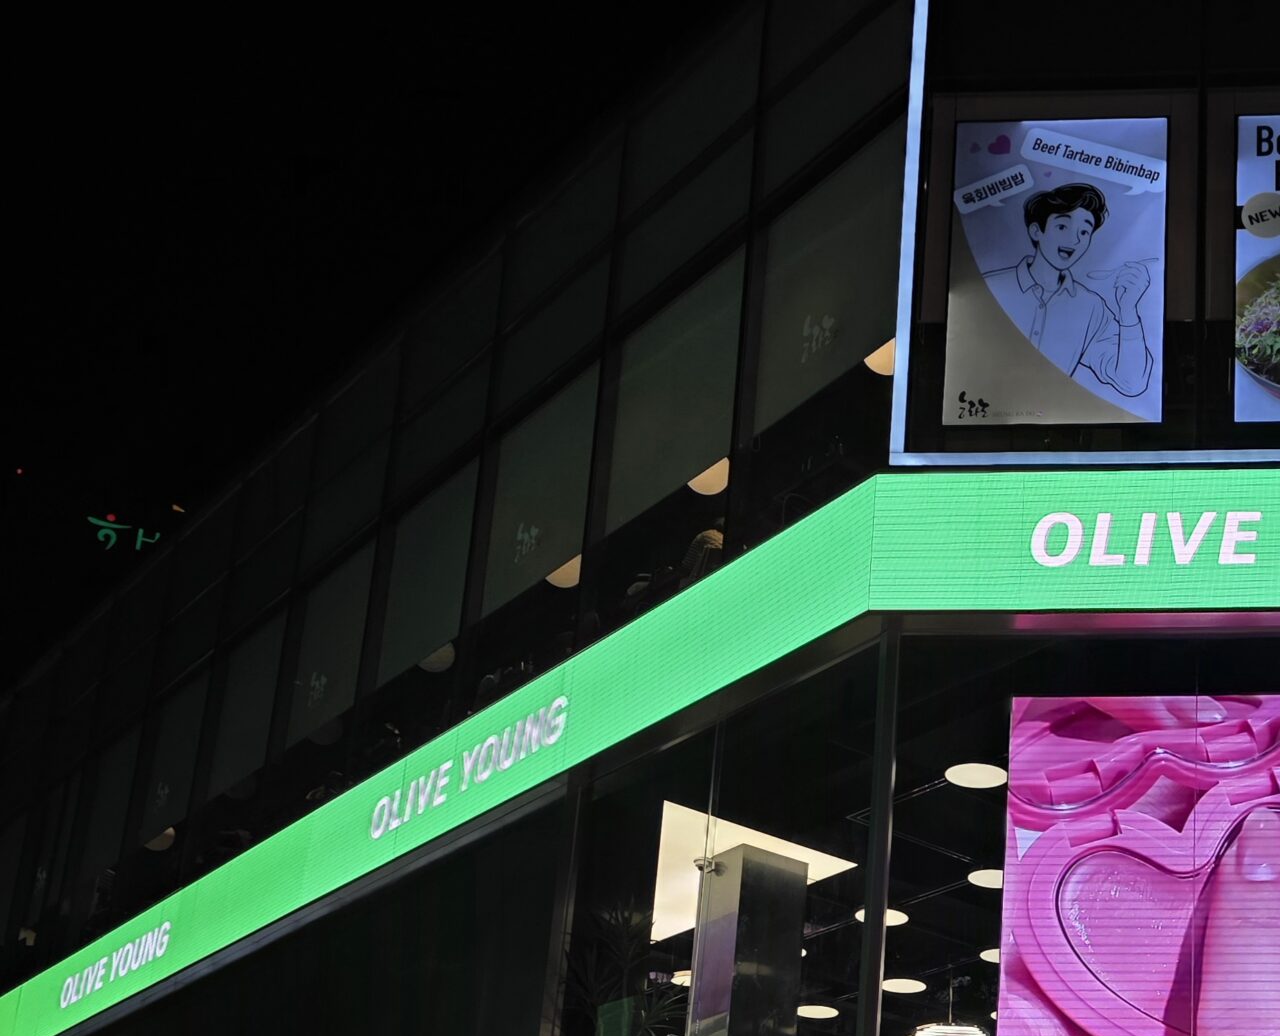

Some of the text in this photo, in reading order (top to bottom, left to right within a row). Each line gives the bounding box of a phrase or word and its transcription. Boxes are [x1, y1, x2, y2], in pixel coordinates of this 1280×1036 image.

[962, 171, 1027, 206] 육회비빔밥
[1031, 137, 1161, 184] Beef Tartare Bibimbap
[1030, 511, 1262, 568] OLIVE
[370, 694, 571, 840] OLIVE YOUNG
[60, 920, 171, 1009] OLIVE YOUNG
